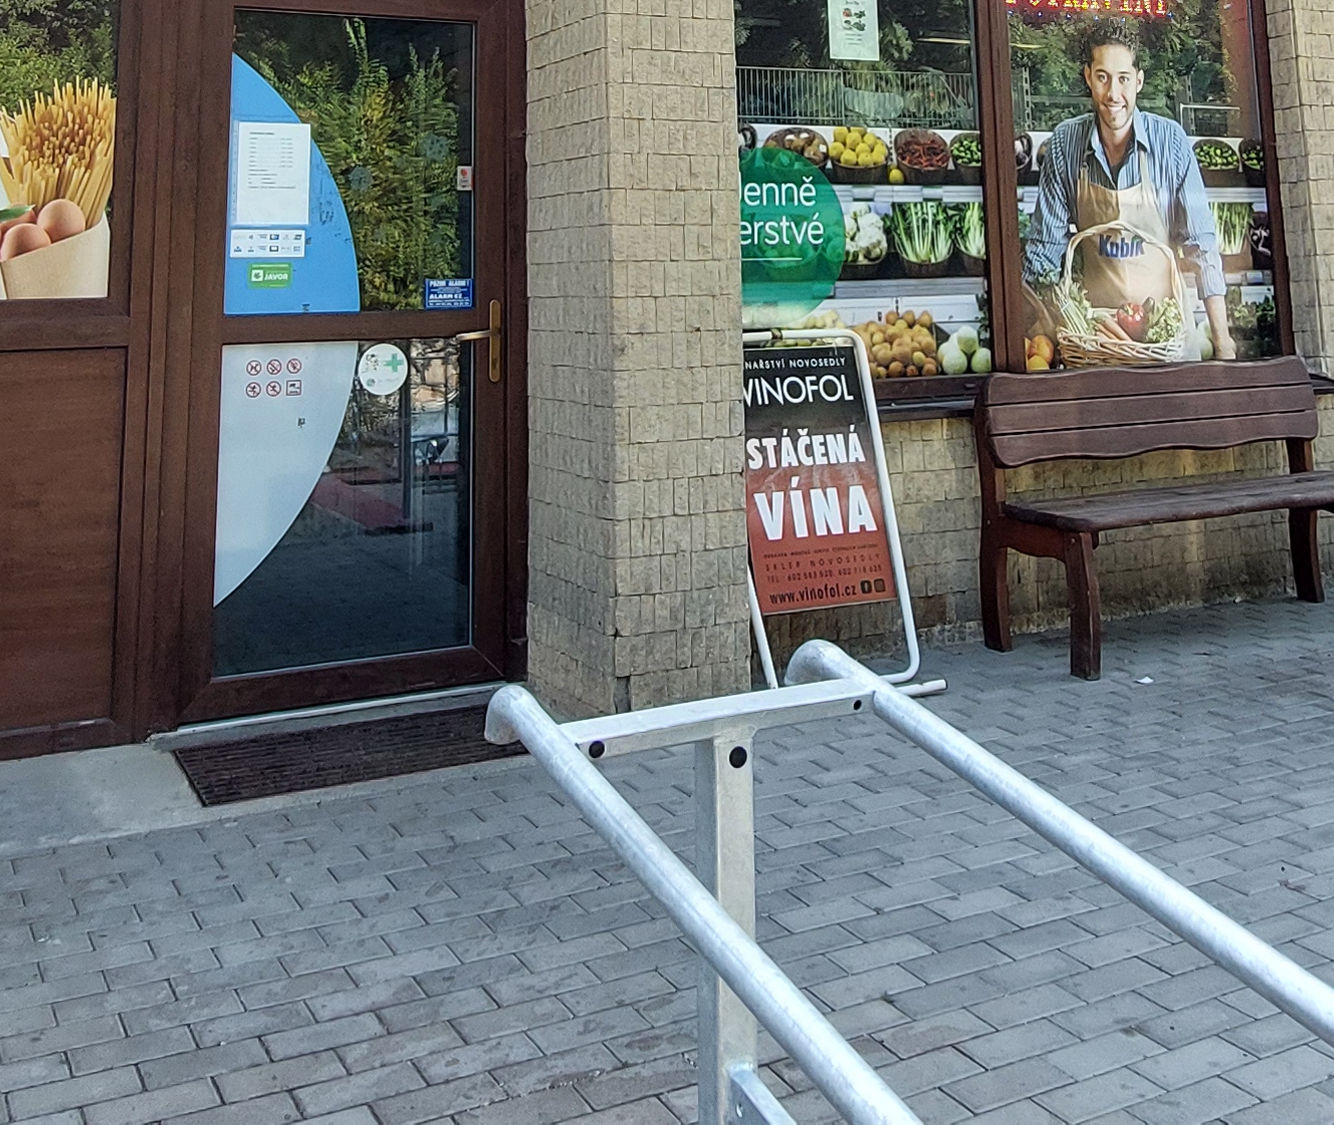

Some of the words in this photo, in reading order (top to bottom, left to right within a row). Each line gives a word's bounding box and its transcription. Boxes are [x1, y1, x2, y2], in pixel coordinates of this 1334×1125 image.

[739, 175, 817, 207] enně
[740, 212, 824, 245] erstvé
[743, 358, 786, 371] NAŘSTVÍ
[789, 357, 846, 368] NOVOSEDLY
[743, 374, 855, 408] VINOFOL
[746, 424, 866, 470] STÁČENÁ
[754, 476, 878, 541] VÍNA
[769, 582, 857, 605] www.vinofol.cz
